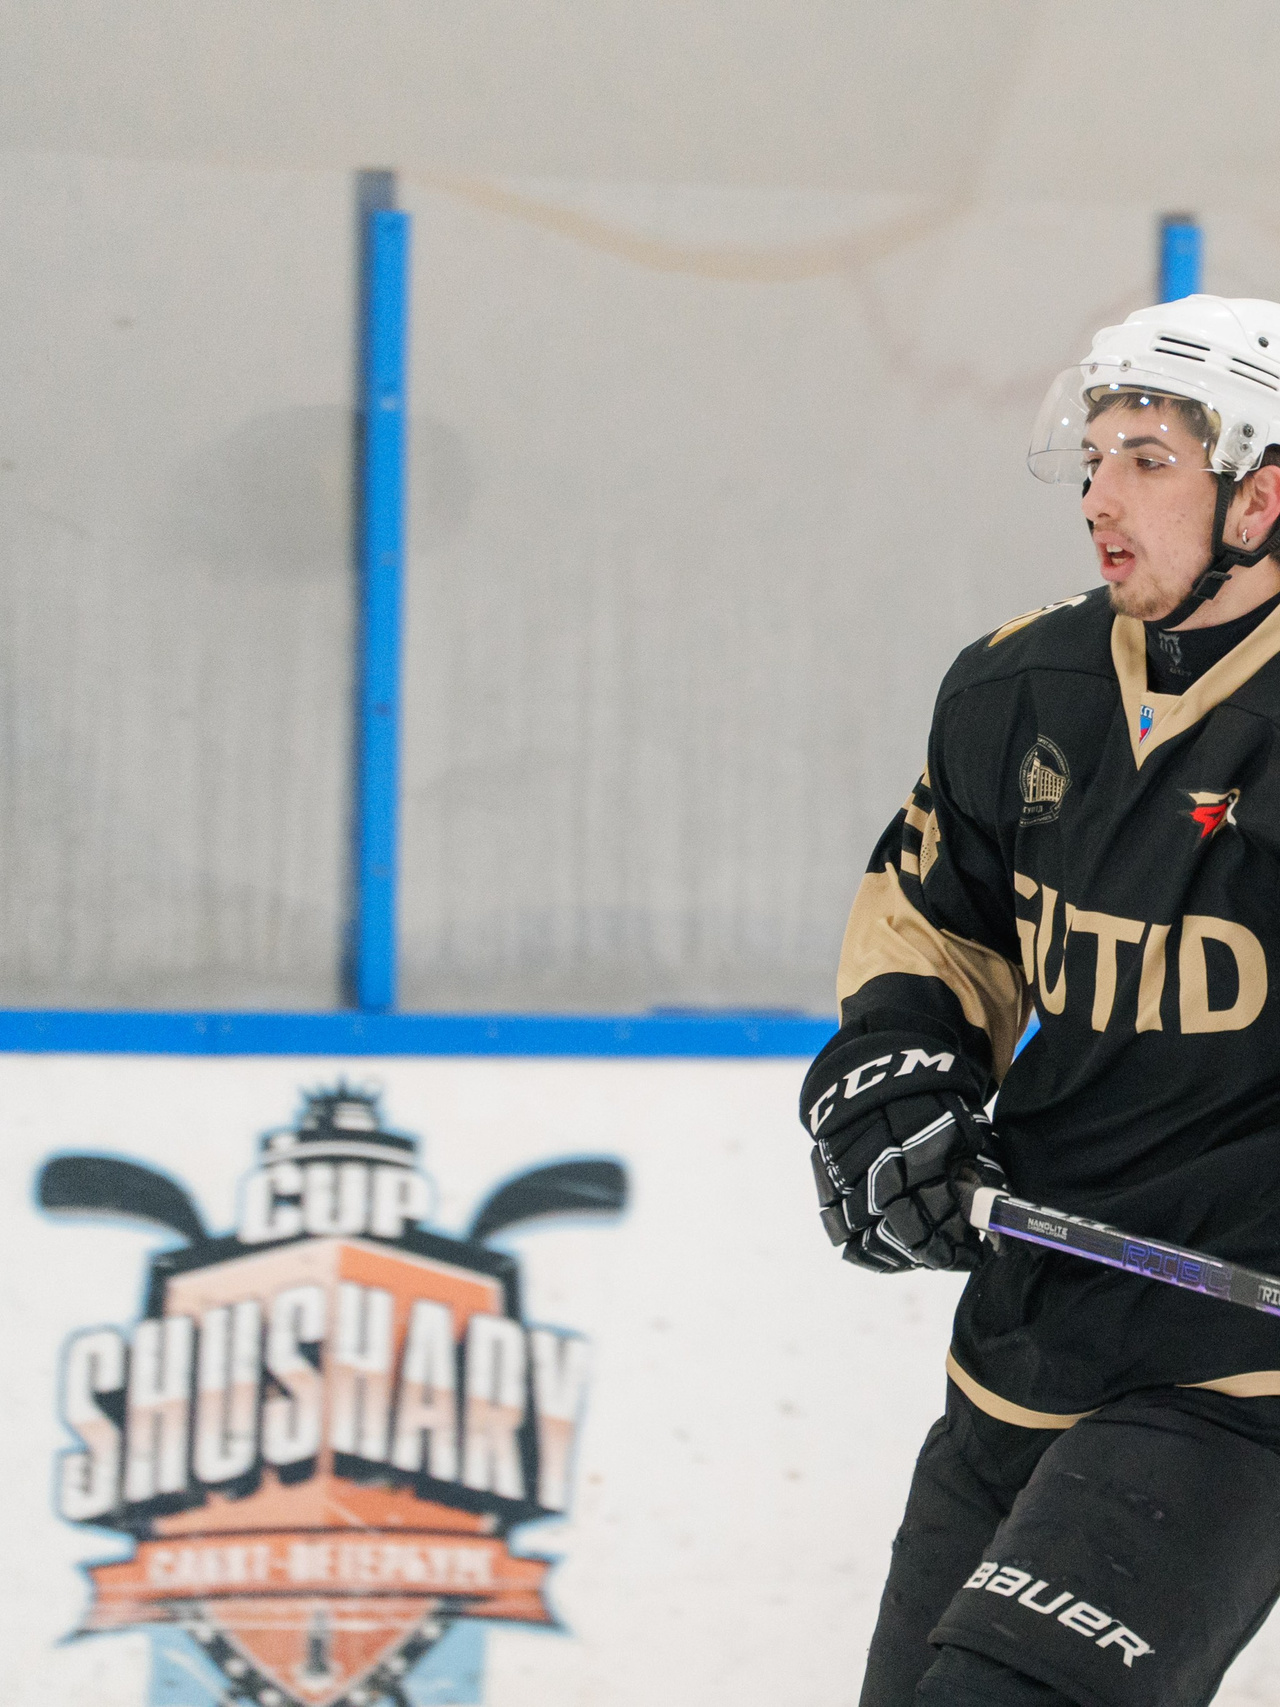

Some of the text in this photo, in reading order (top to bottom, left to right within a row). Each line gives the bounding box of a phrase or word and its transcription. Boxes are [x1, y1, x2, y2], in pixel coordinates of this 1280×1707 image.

[808, 1048, 956, 1136] CCM
[239, 1161, 430, 1246] CUP
[1028, 1217, 1069, 1236] NANOLITE
[61, 1282, 593, 1521] SHUSHARY
[962, 1561, 1153, 1668] BAUER
